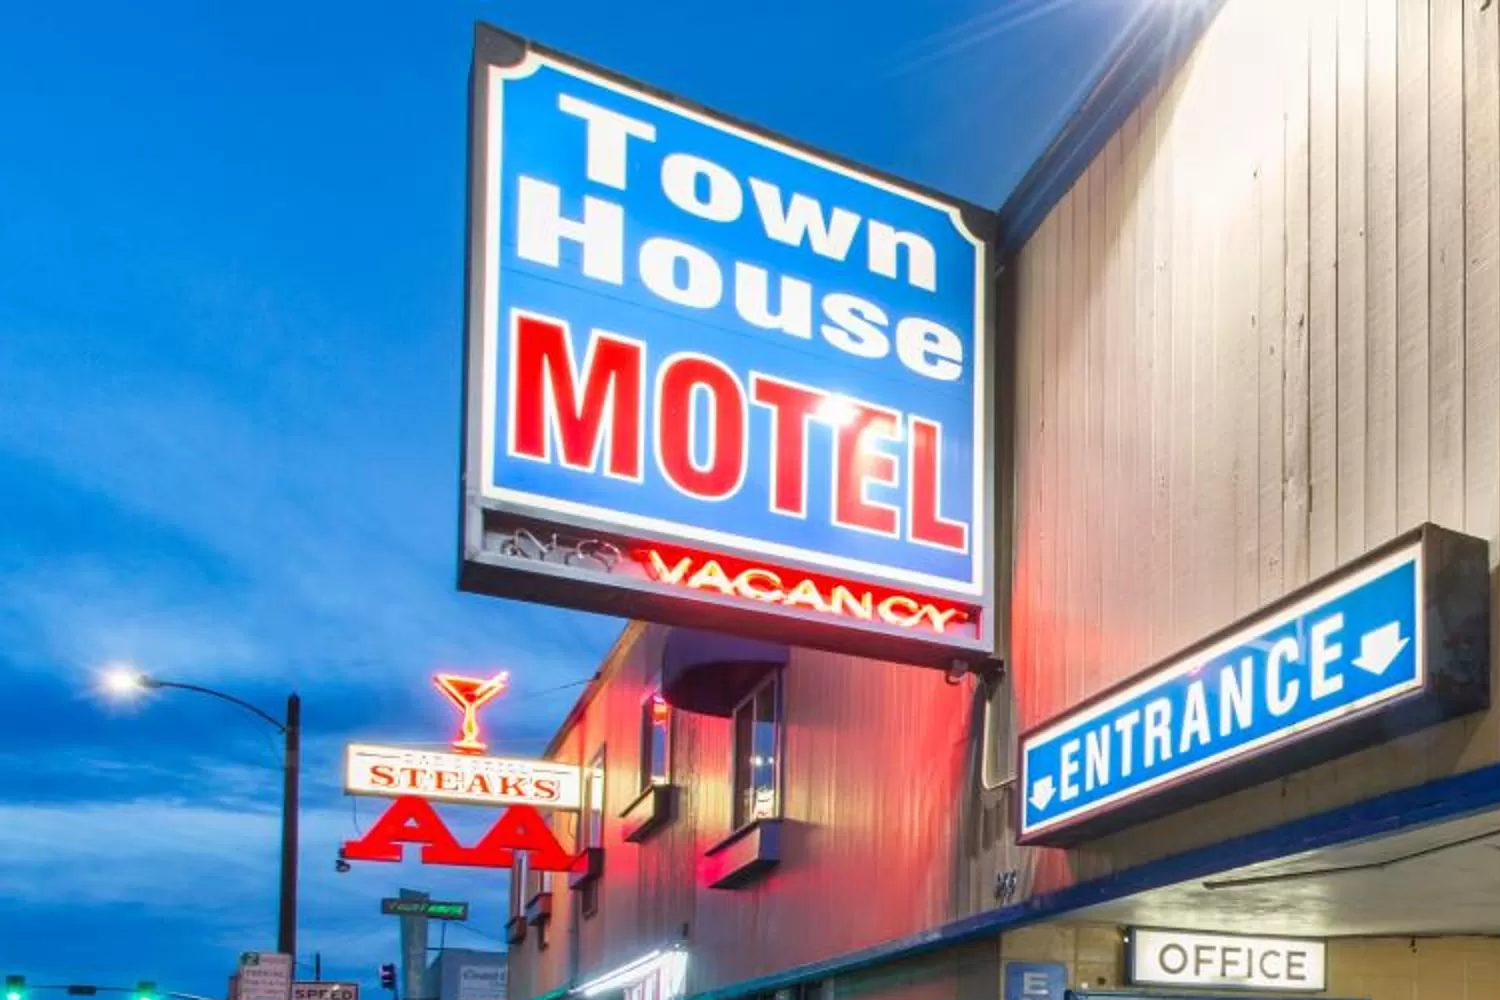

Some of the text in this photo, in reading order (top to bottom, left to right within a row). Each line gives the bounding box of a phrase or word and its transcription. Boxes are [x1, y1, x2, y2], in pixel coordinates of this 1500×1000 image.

[558, 92, 937, 293] Town
[517, 174, 964, 381] House
[509, 308, 968, 554] MOTEL
[646, 548, 962, 634] VACANCY
[1059, 612, 1346, 802] ENTRANCE
[369, 764, 561, 800] STEAKS
[344, 794, 588, 873] AA
[295, 989, 353, 1000] SPEED
[1158, 942, 1308, 982] OFFICE
